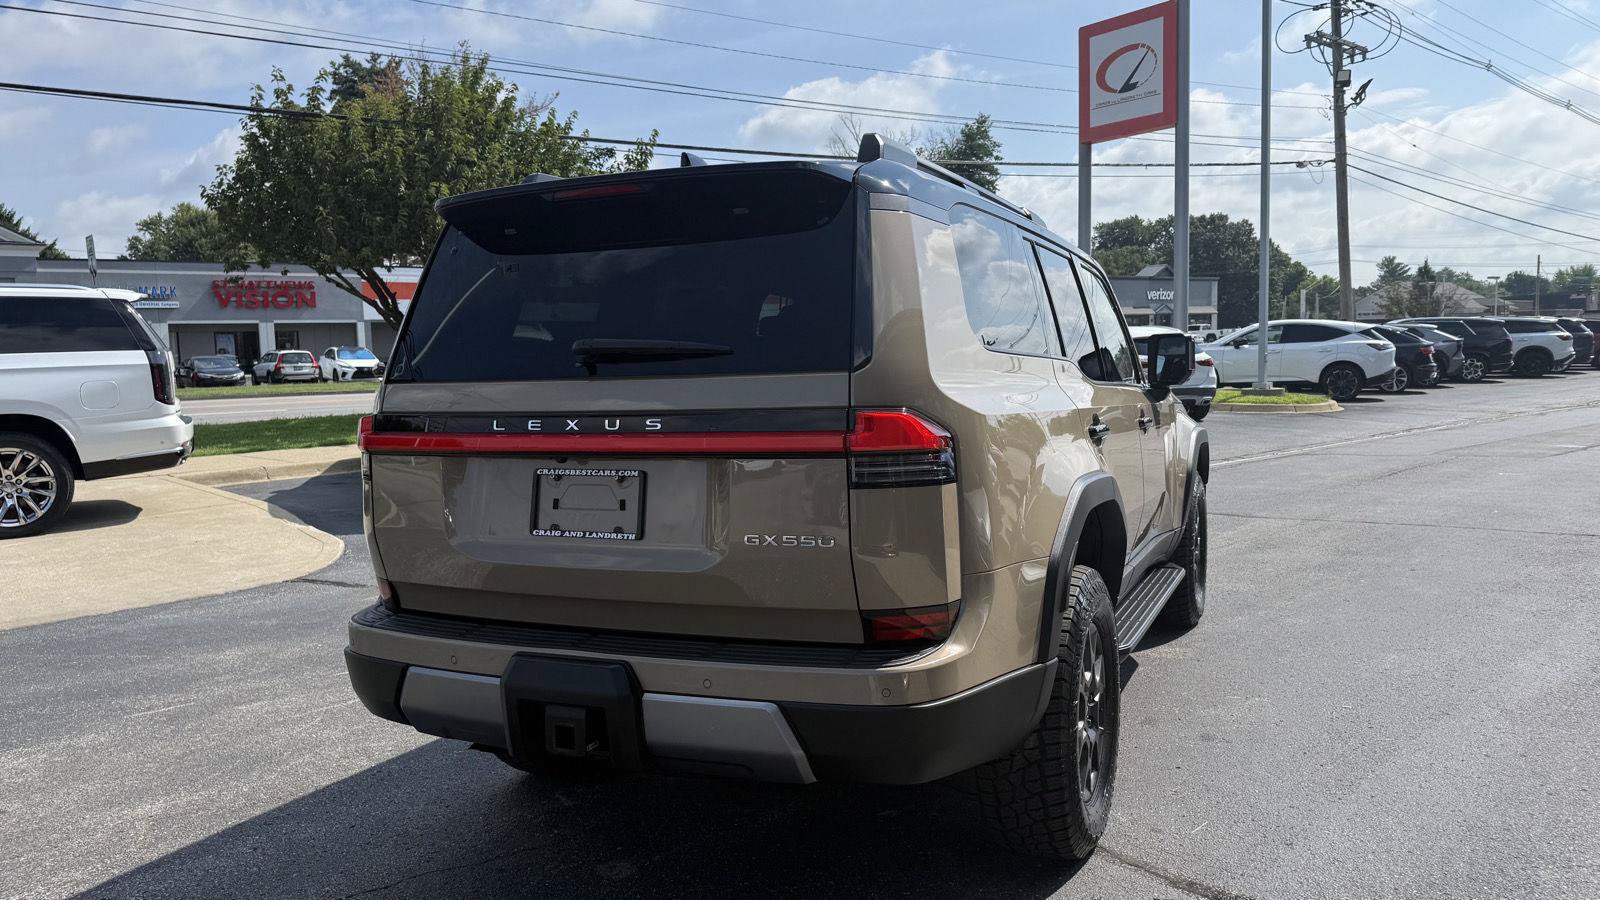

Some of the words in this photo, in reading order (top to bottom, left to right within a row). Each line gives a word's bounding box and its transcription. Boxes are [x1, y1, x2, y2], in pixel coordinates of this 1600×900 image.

[212, 290, 316, 309] VISION
[492, 418, 663, 431] LEXUS
[536, 468, 639, 477] CRAIGSBESTCARS.COM
[532, 529, 562, 537] CRAIG
[563, 530, 584, 538] AND
[585, 531, 636, 540] LANDRETH
[743, 534, 835, 548] GX550
